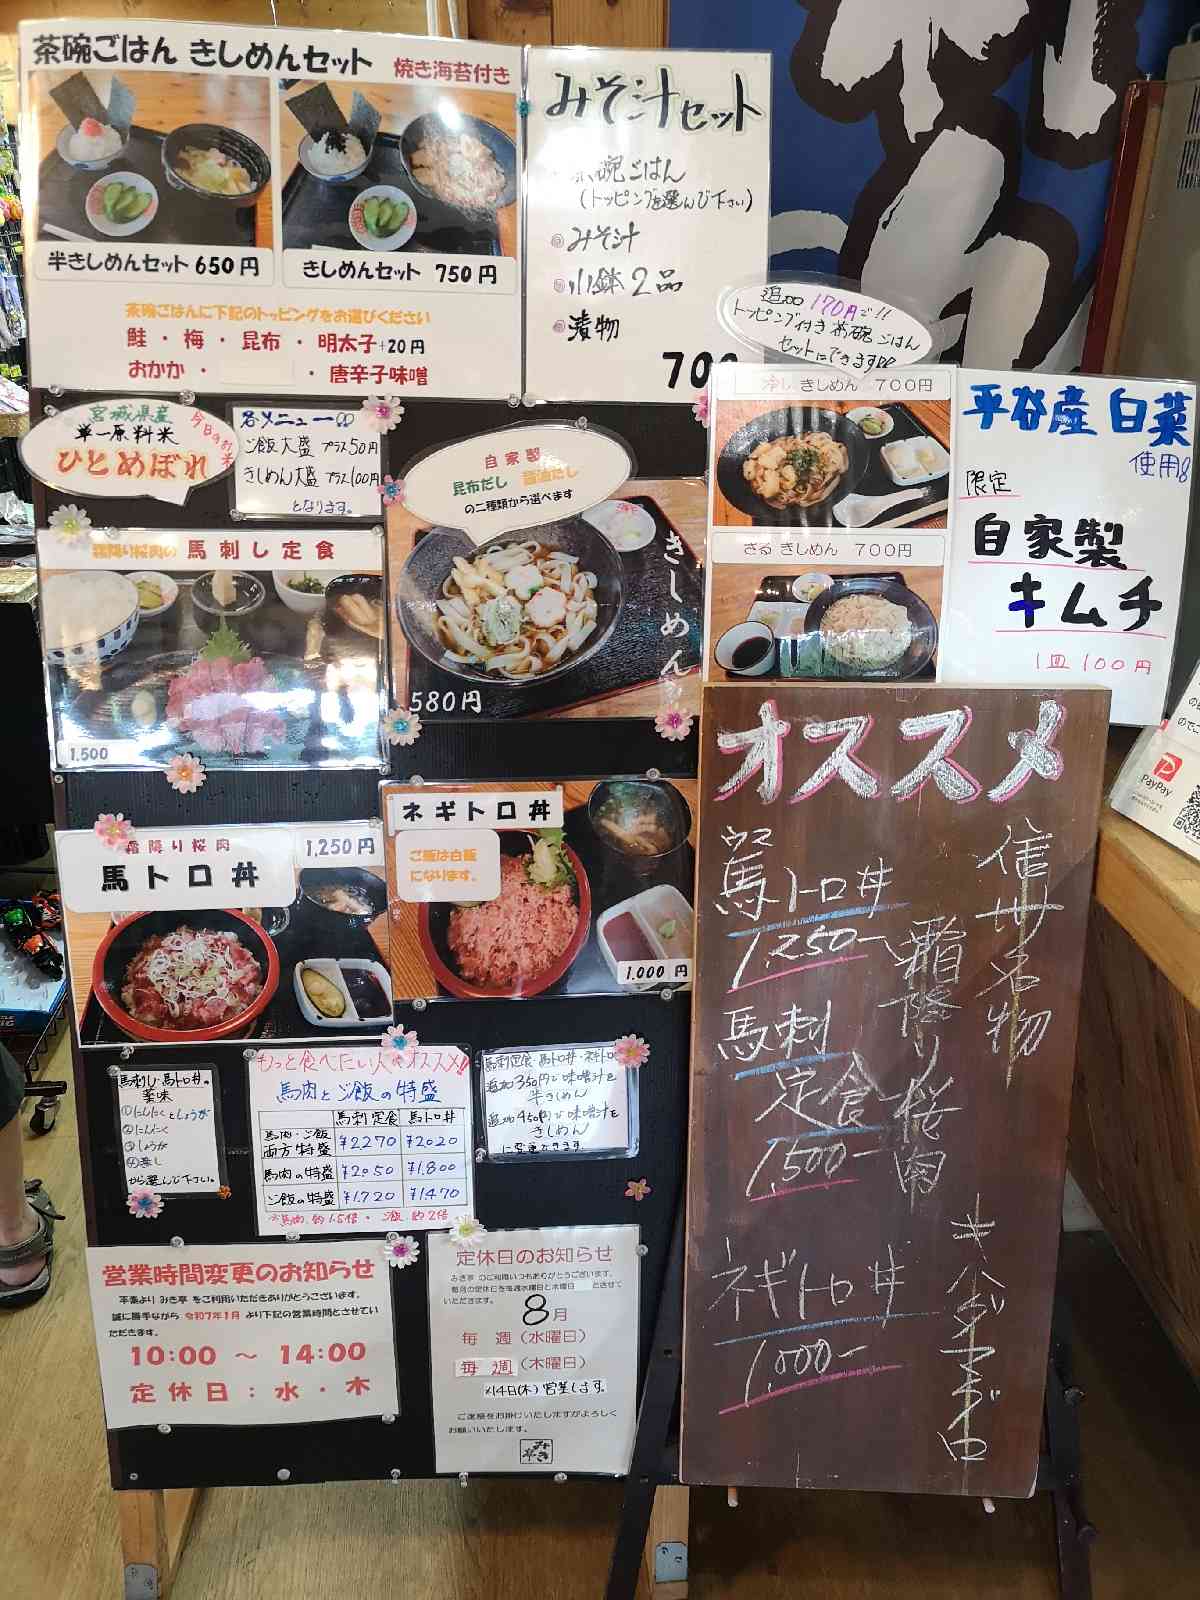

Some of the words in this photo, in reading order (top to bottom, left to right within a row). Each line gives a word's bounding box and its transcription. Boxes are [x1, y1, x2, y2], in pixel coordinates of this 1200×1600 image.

[33, 35, 177, 66] 茶碗ごはん
[190, 39, 373, 76] きしめんセット
[393, 58, 511, 85] 焼き海苔付き
[546, 67, 762, 132] みそ汁セット
[574, 155, 687, 183] 碗ごはん
[567, 221, 641, 252] みそ汁
[48, 252, 189, 275] 半きしめんセット
[195, 255, 259, 277] 650円
[303, 260, 421, 282] きしめんセット
[435, 262, 498, 285] 750円
[567, 309, 620, 342] 漬物
[800, 378, 858, 392] きしめん
[875, 378, 933, 392] 700円
[88, 405, 173, 424] 宮城県産
[240, 410, 355, 428] 各メニューの
[1110, 388, 1193, 447] 白菜
[75, 424, 179, 446] 単一原料米
[245, 435, 315, 458] ご飯大盛
[56, 448, 209, 481] ひとめぼれ
[485, 447, 541, 469] 自家製
[243, 466, 320, 488] きしめん大盛
[453, 476, 508, 496] 昆布だし
[966, 470, 1012, 496] 限定
[464, 489, 573, 514] の二種類から選べます
[186, 539, 335, 560] 馬刺し定食
[780, 542, 838, 556] きしめん
[855, 543, 913, 558] 700円
[974, 513, 1127, 570] 自家製
[660, 529, 690, 677] きしめん
[1008, 571, 1163, 632] キムチ
[409, 690, 482, 713] 580円
[713, 699, 1068, 804] オススメ
[1141, 774, 1172, 798] PayPay
[402, 799, 551, 822] ネギトロ丼
[100, 861, 259, 893] 馬トロ丼
[456, 1245, 613, 1267] 定休日のお知らせ
[102, 1259, 375, 1287] 営業時間変更のお知らせ
[522, 1294, 568, 1325] 8月
[131, 1345, 217, 1367] 10:00
[280, 1341, 367, 1365] 14:00
